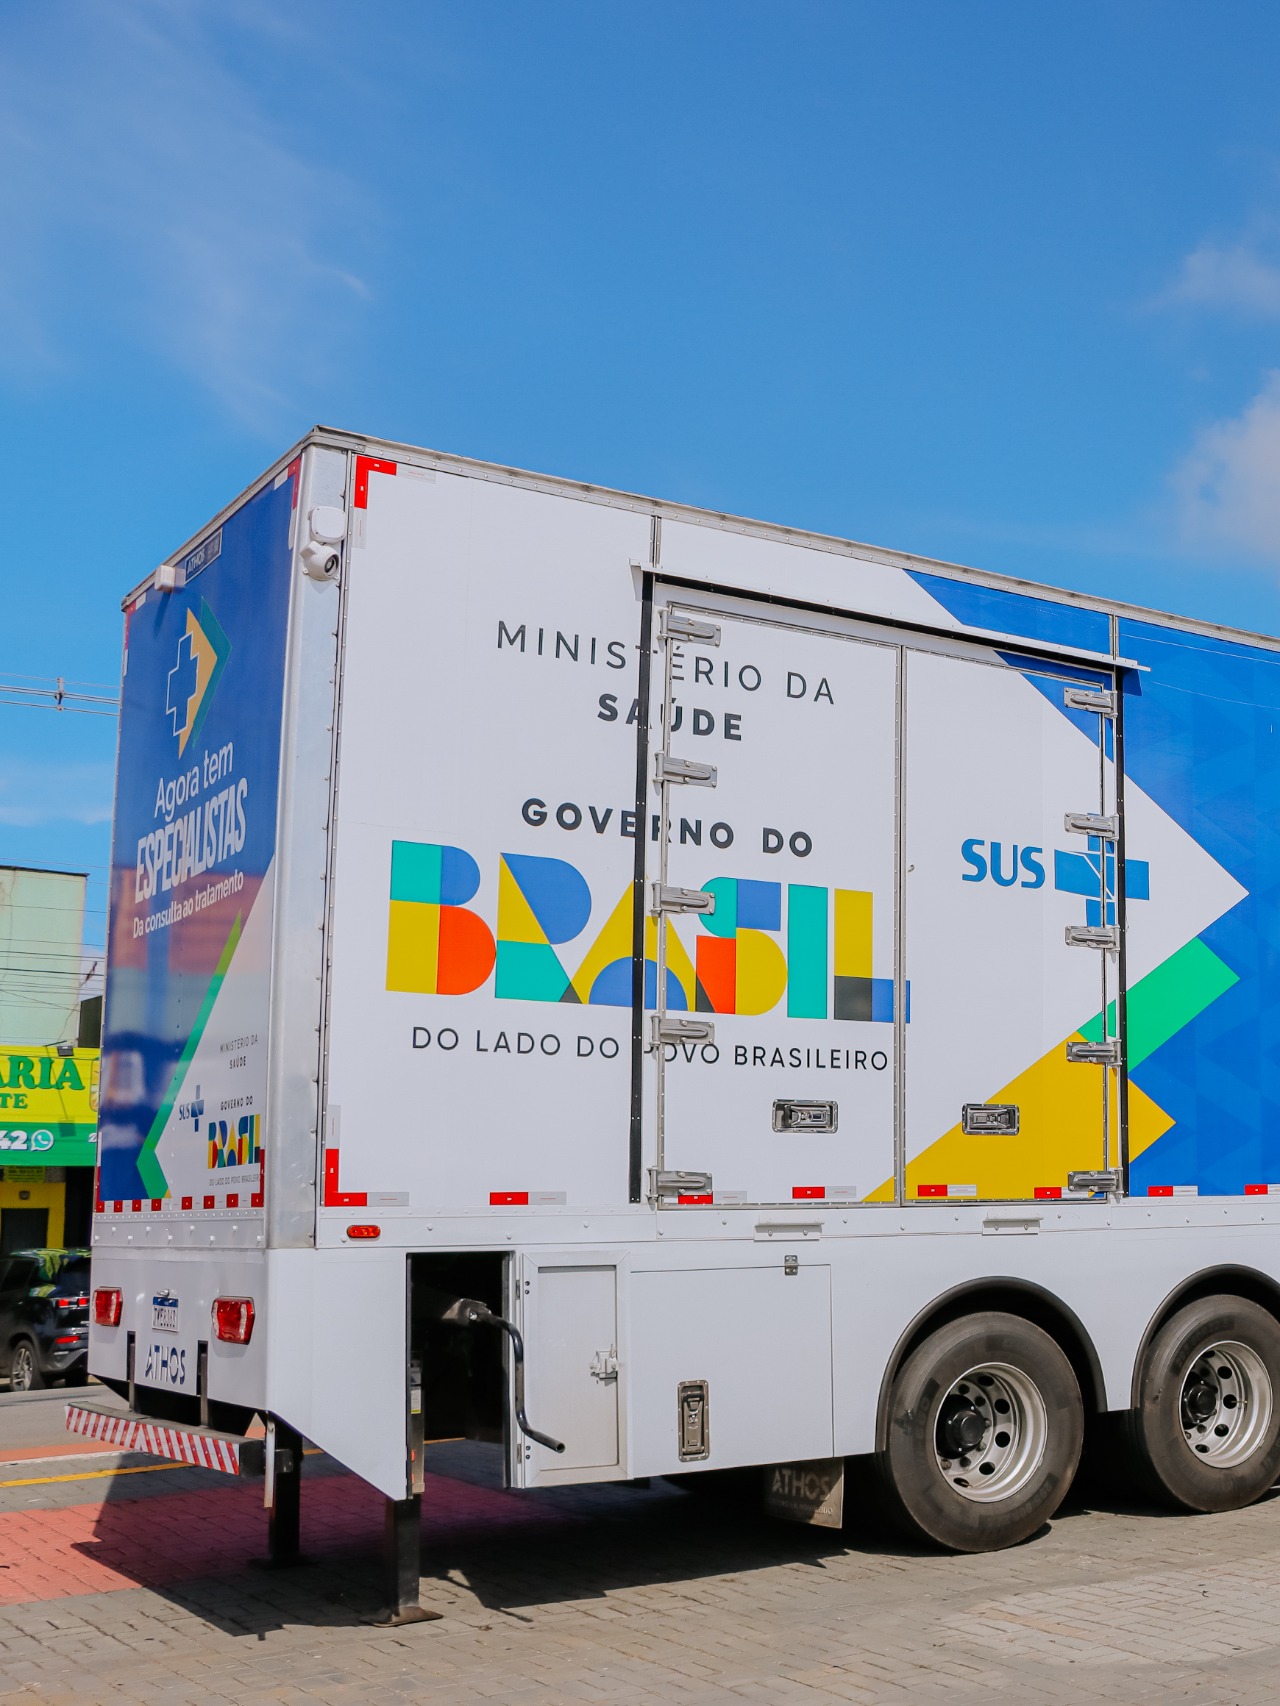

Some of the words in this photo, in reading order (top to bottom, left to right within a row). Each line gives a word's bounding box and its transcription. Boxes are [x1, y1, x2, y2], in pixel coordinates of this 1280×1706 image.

[497, 620, 762, 692] MINISÉRIO
[786, 671, 835, 705] DA
[154, 765, 199, 823] Agora
[203, 741, 234, 789] tem
[135, 777, 248, 904] ESPECIALISTAS
[521, 797, 734, 849] GOVERNO
[762, 827, 813, 858] DO
[960, 838, 1046, 889] SUS
[133, 917, 144, 939] Da
[145, 899, 182, 931] consulta
[182, 897, 194, 918] ao
[195, 869, 244, 913] tratamento
[386, 840, 911, 1024] BRASIL
[250, 1033, 259, 1045] DA
[412, 1026, 460, 1051] DO
[476, 1030, 561, 1057] LADO
[576, 1035, 620, 1060] DO
[734, 1045, 888, 1071] BRASILEIRO
[0, 1055, 86, 1091] RIA
[229, 1055, 247, 1069] SAÚDE
[178, 1102, 191, 1121] SUS
[220, 1097, 244, 1111] GOVERNO
[245, 1095, 254, 1106] DO
[207, 1113, 261, 1169] BRASIL
[241, 1173, 260, 1184] BRASILEIR
[144, 1343, 186, 1385] ATHOS
[771, 1467, 832, 1501] ATHOS
